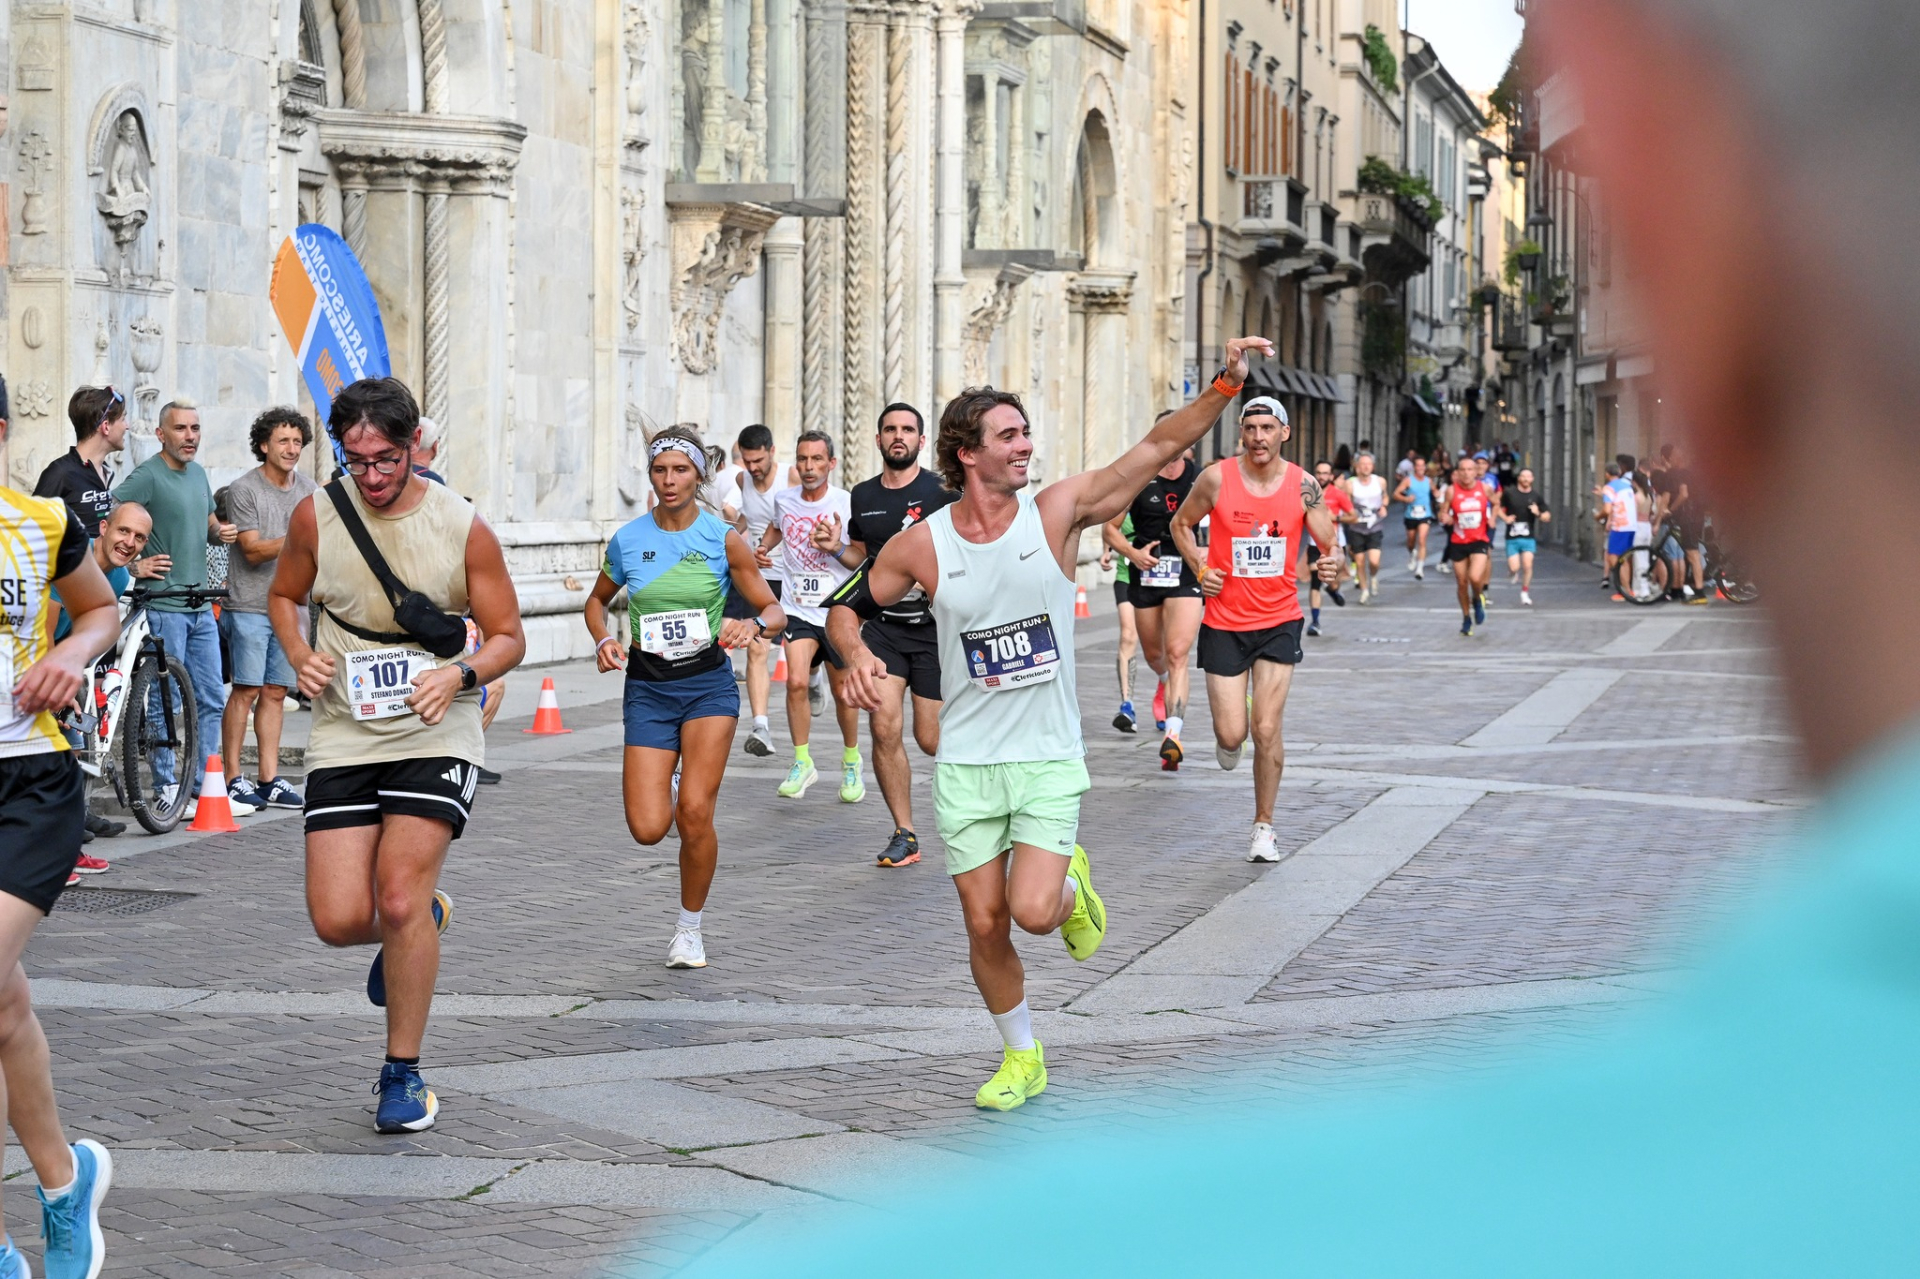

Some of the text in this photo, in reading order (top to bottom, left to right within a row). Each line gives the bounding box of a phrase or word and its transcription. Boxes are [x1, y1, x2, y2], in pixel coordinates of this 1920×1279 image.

[642, 551, 656, 560] SLP
[1246, 546, 1271, 560] 104
[803, 578, 819, 591] 30
[643, 615, 664, 623] COMO
[661, 620, 687, 640] 55
[967, 617, 1042, 640] COMO NIGHT RUN
[984, 630, 1032, 663] 708
[351, 655, 375, 664] COMO
[377, 650, 405, 661] NIGHT
[368, 659, 409, 689] 107
[370, 691, 393, 699] STEFANO
[393, 687, 413, 697] DONATO
